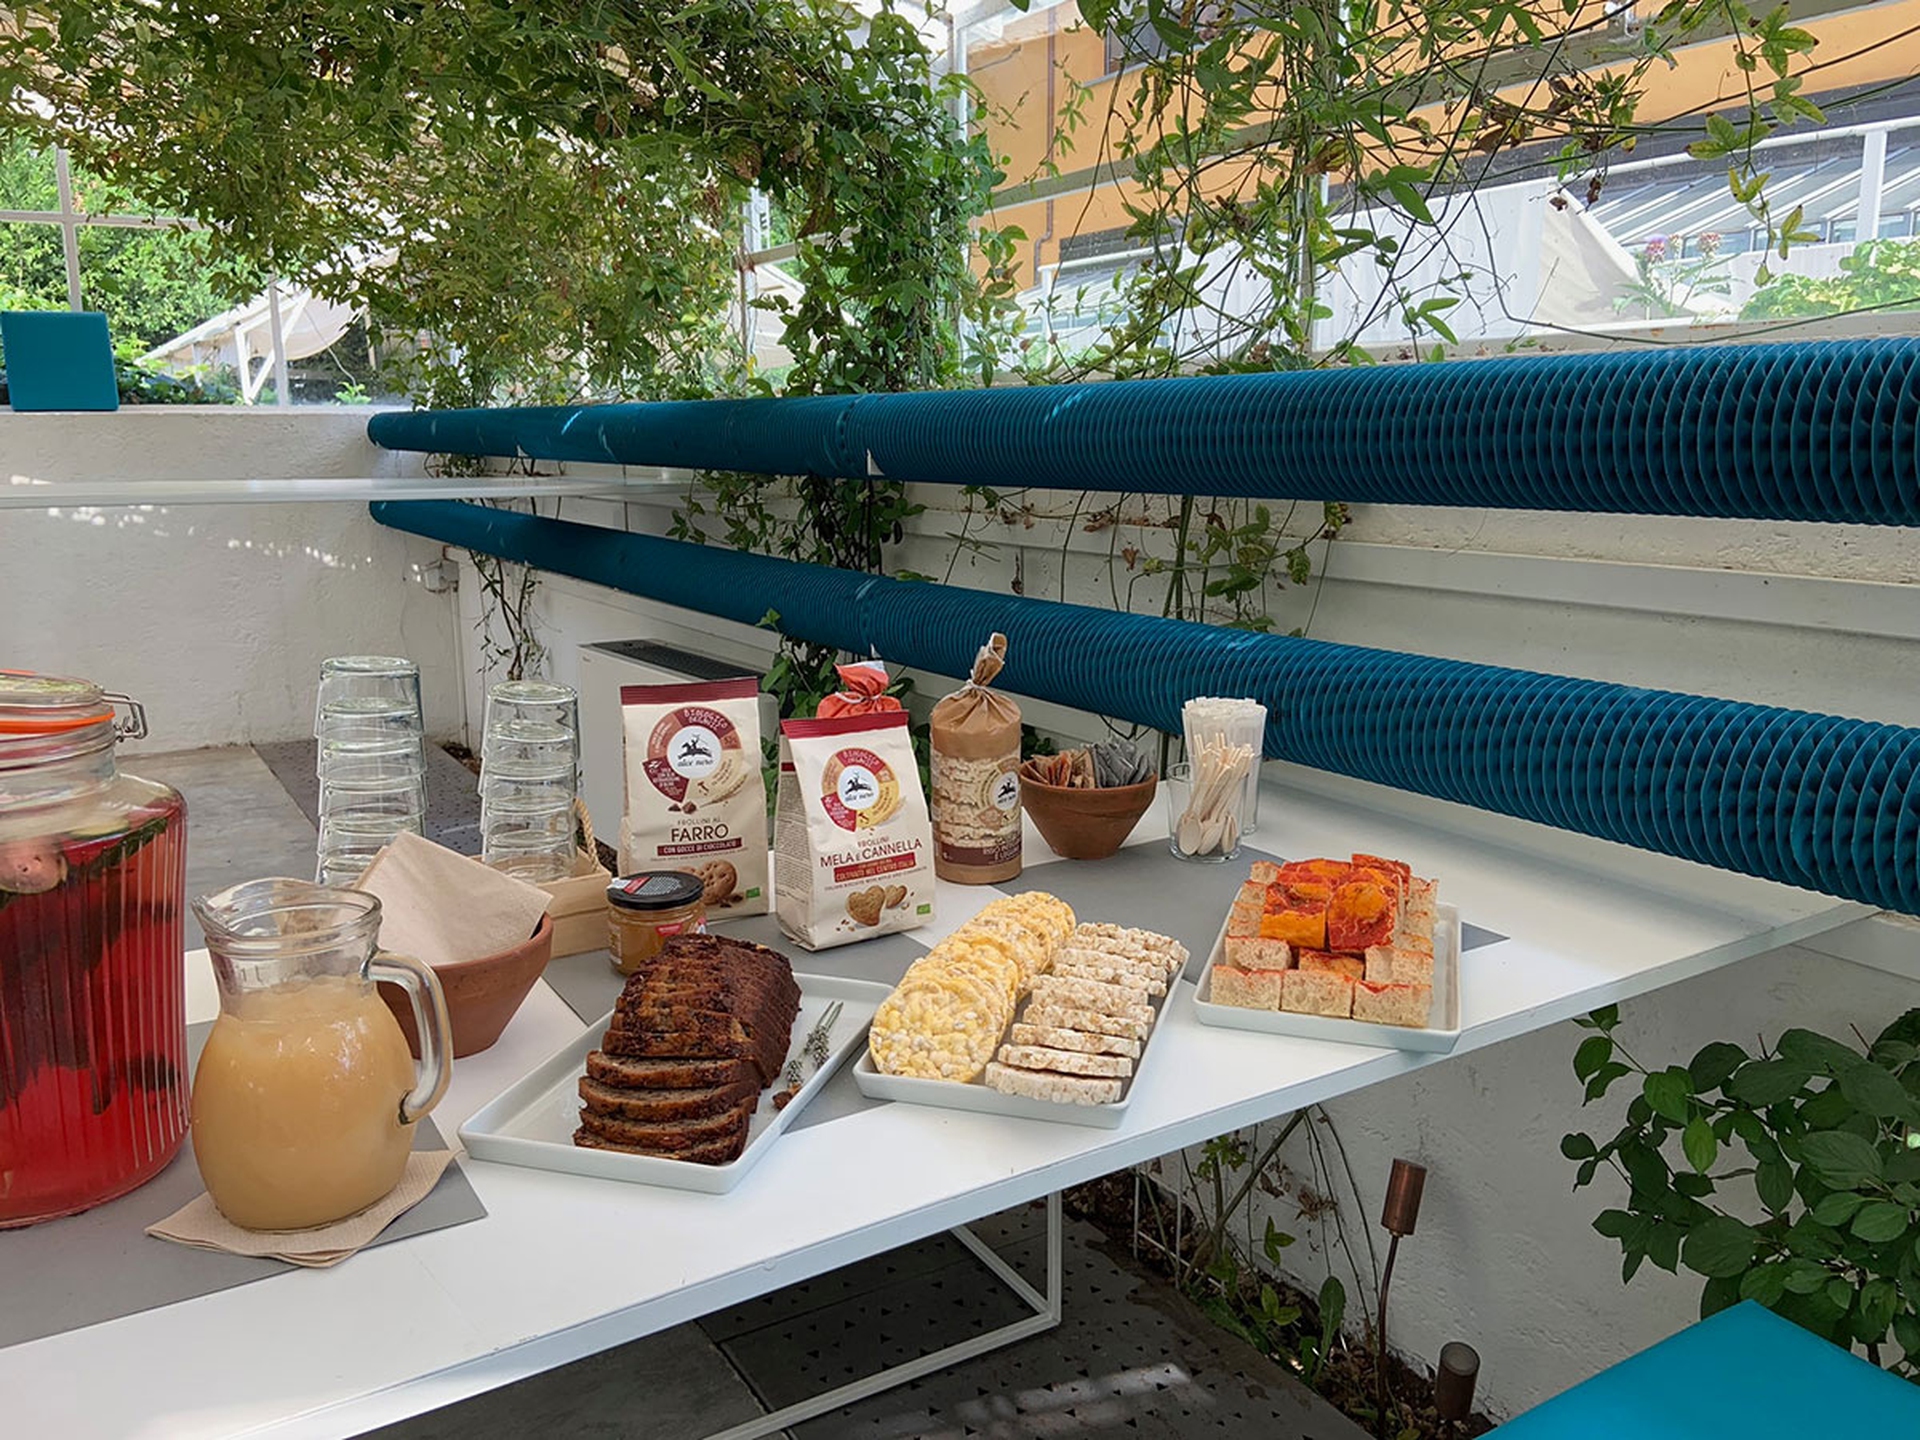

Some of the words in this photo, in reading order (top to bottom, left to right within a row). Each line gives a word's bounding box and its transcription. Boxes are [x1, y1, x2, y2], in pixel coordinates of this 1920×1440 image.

[671, 823, 729, 842] FARRO
[820, 852, 854, 868] MELA
[861, 838, 923, 860] CANNELLA
